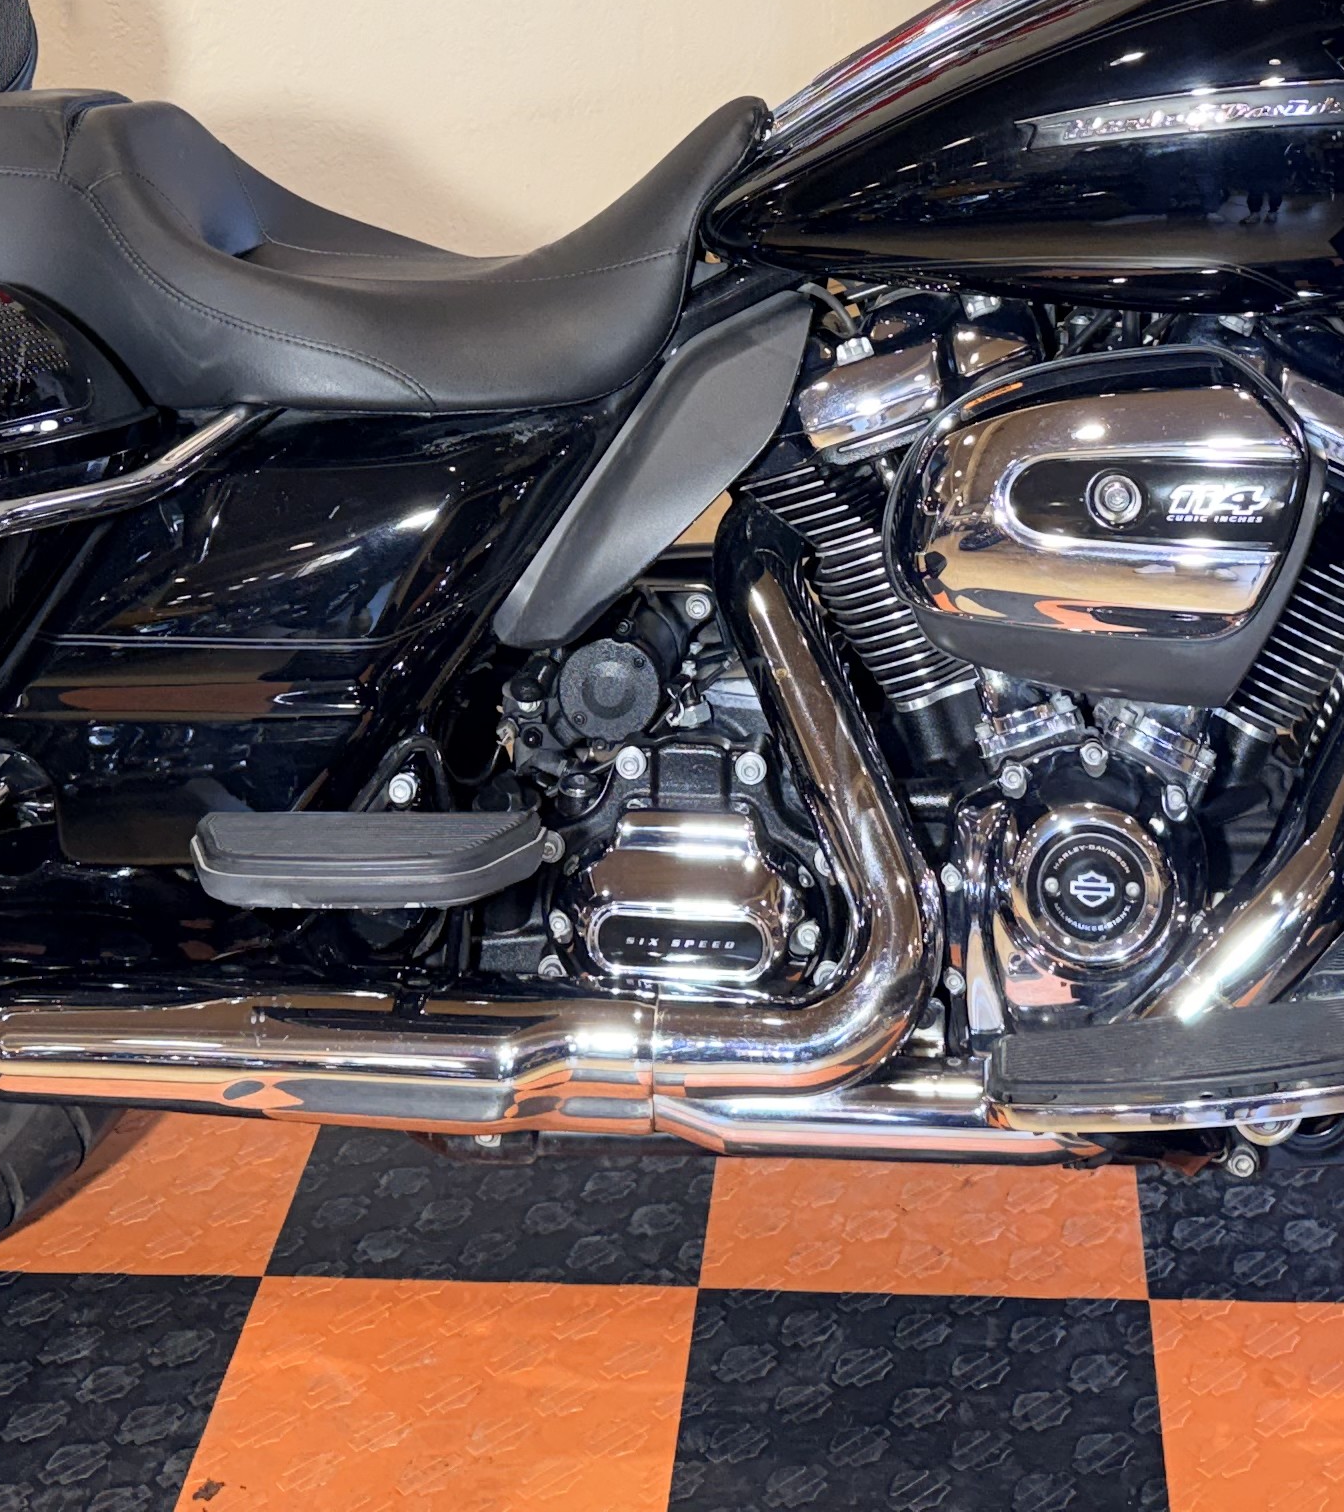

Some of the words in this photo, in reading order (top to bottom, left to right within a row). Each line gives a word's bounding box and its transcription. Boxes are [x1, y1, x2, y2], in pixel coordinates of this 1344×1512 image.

[1167, 484, 1272, 516] 114
[1165, 514, 1209, 523] CUBIC
[1213, 515, 1264, 524] INCHES
[1052, 843, 1131, 874] HARLEY-DAVIDSON
[1053, 902, 1132, 932] MILWAUKEE-EIGHT
[625, 936, 660, 947] SIX
[670, 939, 736, 949] SPEED
